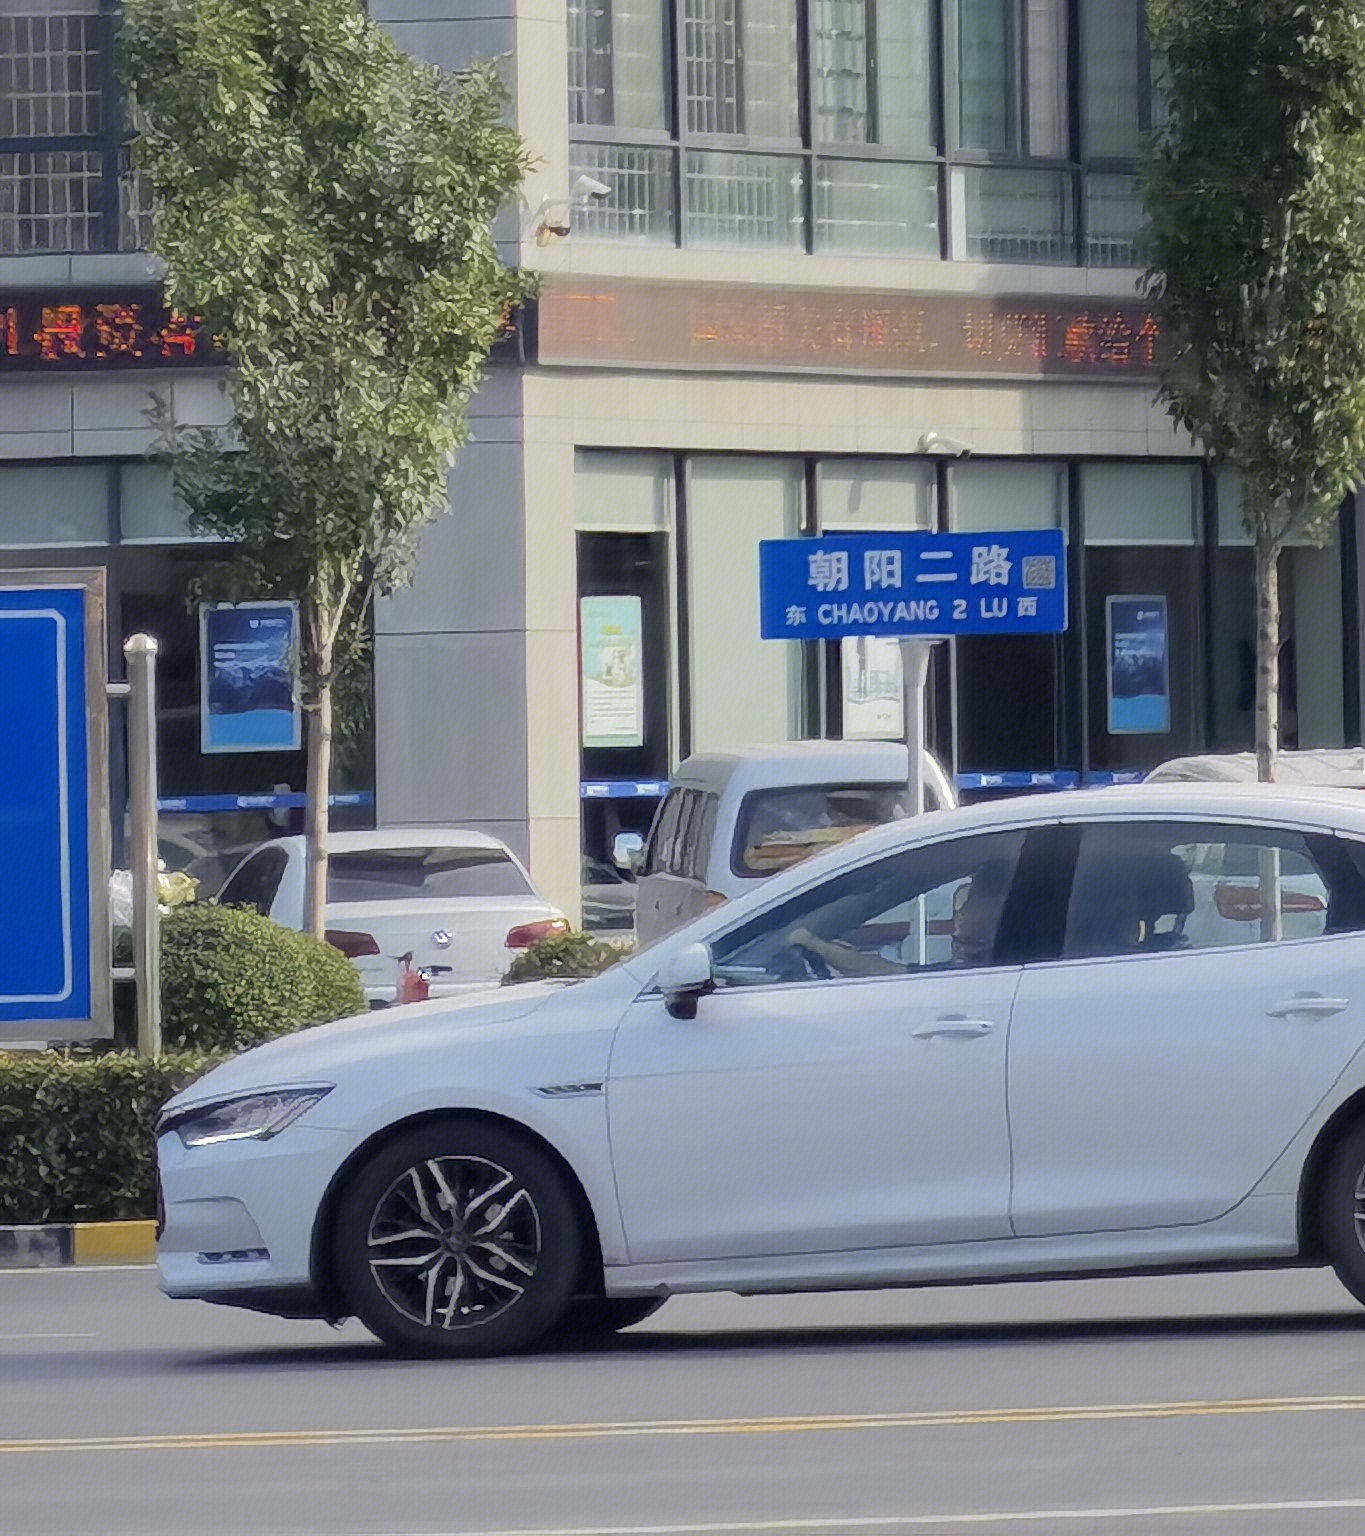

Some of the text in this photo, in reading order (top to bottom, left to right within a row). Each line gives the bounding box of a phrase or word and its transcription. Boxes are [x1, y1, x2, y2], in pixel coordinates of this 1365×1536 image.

[807, 544, 1014, 592] 朝阳二路
[786, 596, 1038, 627] 东 CHAOYANG 2 LU 西
